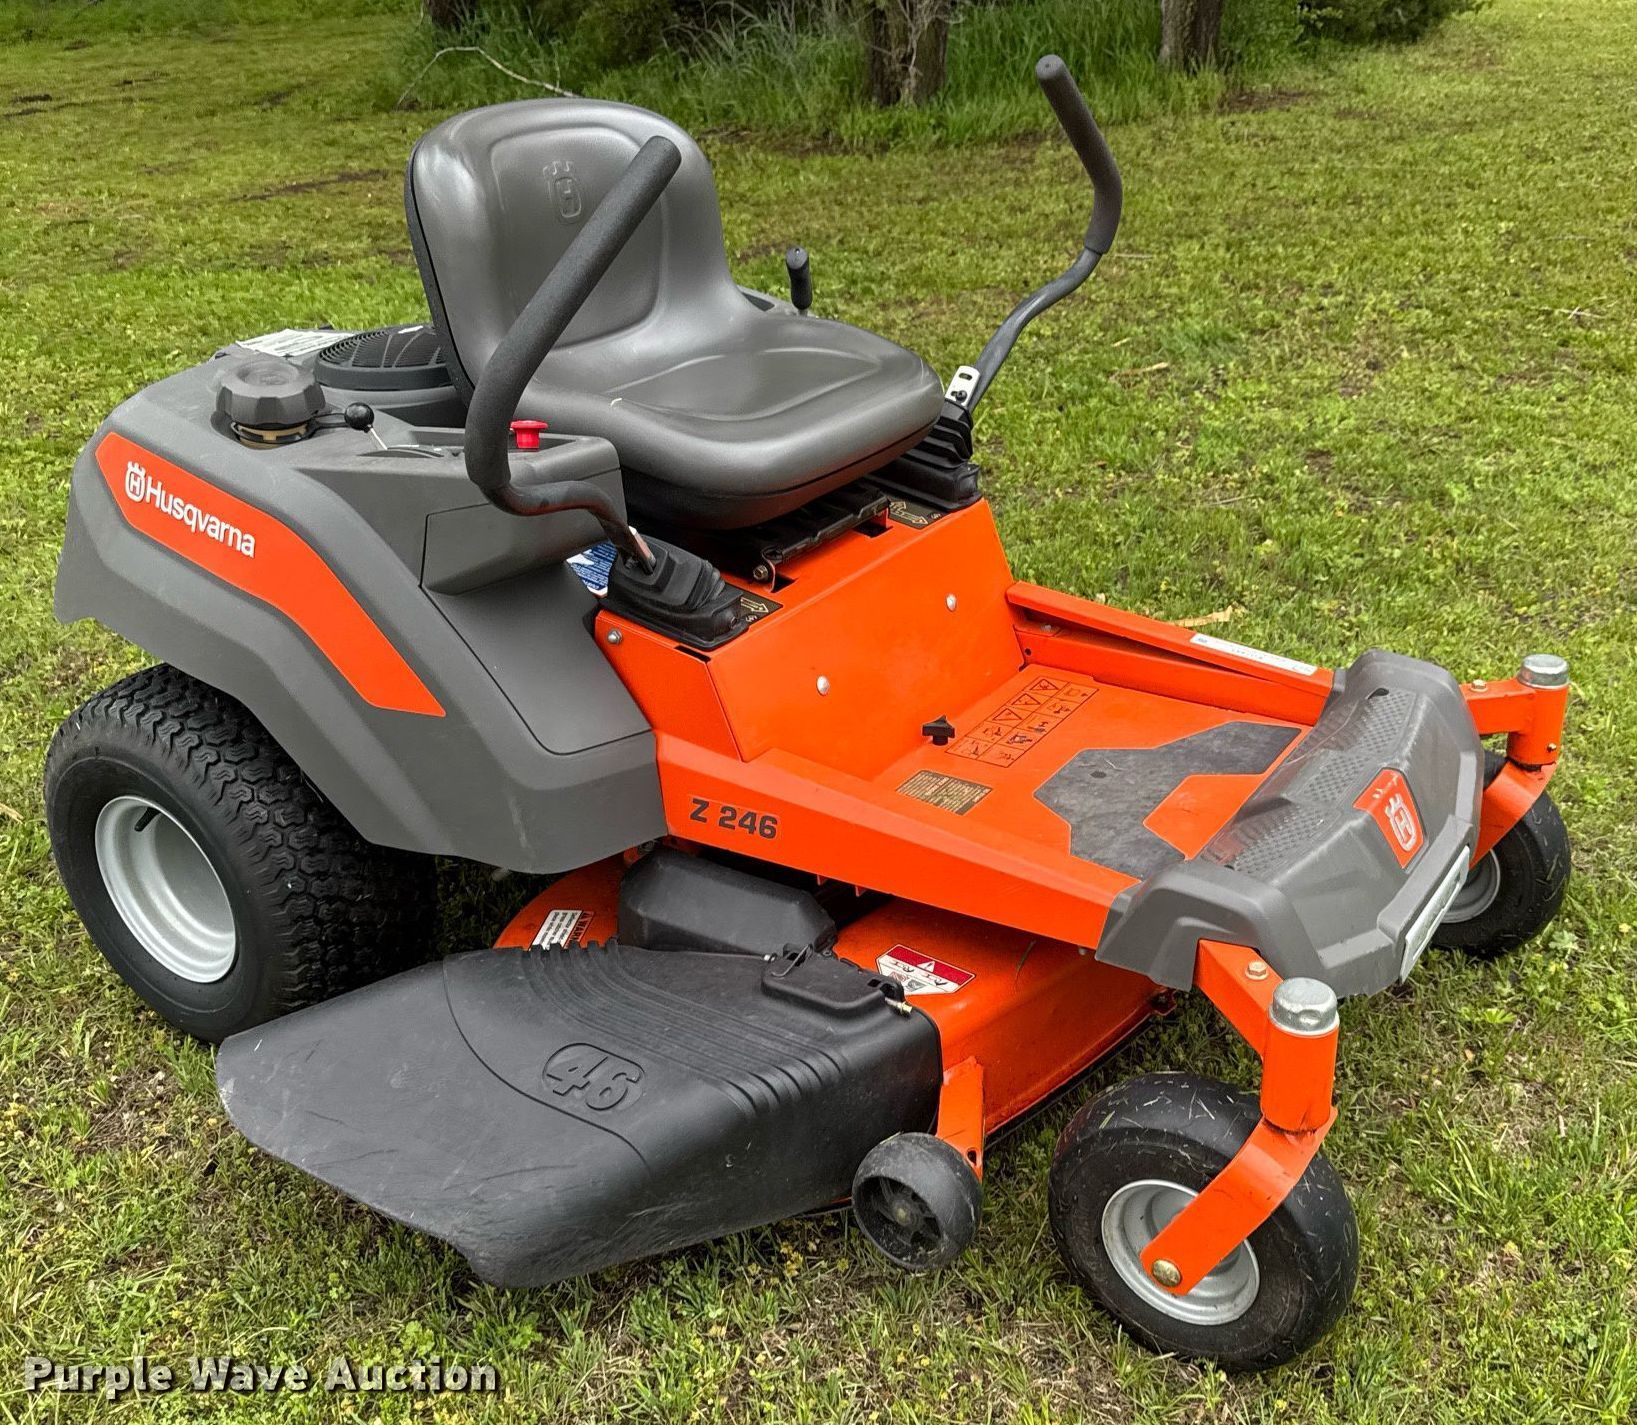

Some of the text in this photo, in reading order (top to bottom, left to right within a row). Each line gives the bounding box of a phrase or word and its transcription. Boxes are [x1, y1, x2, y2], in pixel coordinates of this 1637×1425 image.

[145, 476, 255, 558] Husqvarna
[690, 798, 778, 839] Z 246
[545, 1053, 641, 1111] 46
